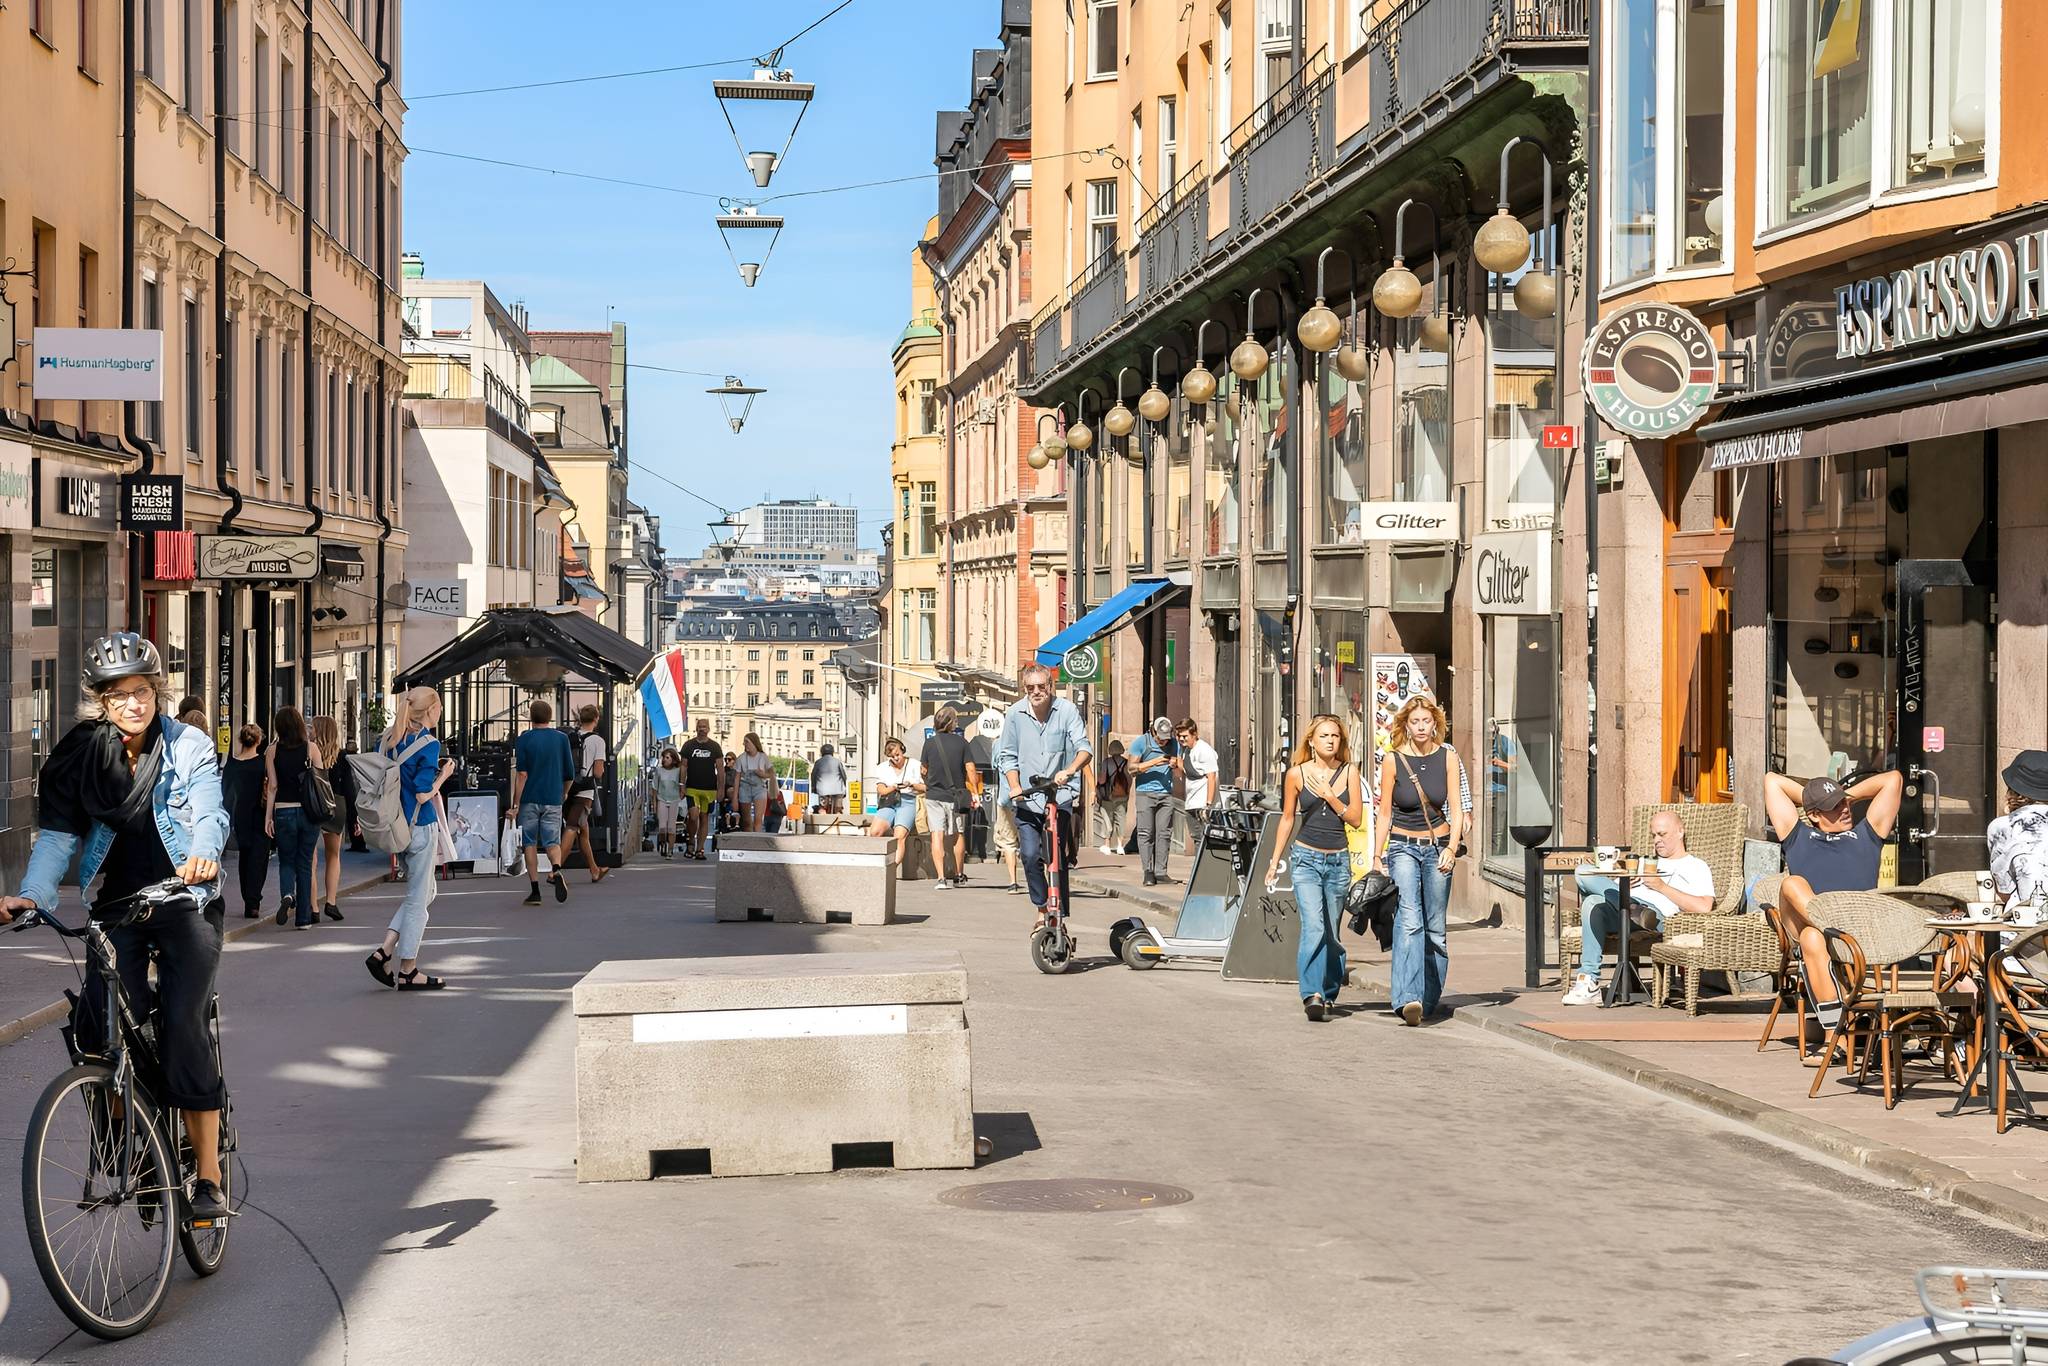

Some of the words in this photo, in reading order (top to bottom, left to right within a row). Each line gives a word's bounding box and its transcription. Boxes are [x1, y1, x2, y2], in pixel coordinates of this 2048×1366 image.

[1834, 241, 2016, 360] ESPRESSO
[1597, 311, 1707, 359] ESPRESSO
[1608, 398, 1696, 429] HOUSE
[1560, 432, 1568, 441] 4
[1711, 433, 1763, 468] ESPRESSO
[1763, 428, 1803, 461] HOUSE
[68, 477, 94, 517] LUSH
[132, 485, 172, 496] LUSH
[132, 497, 172, 507] FRESH
[1376, 514, 1446, 529] Glitter
[251, 562, 287, 572] MUSIC
[1477, 549, 1529, 604] Glitter
[415, 587, 459, 603] FACE
